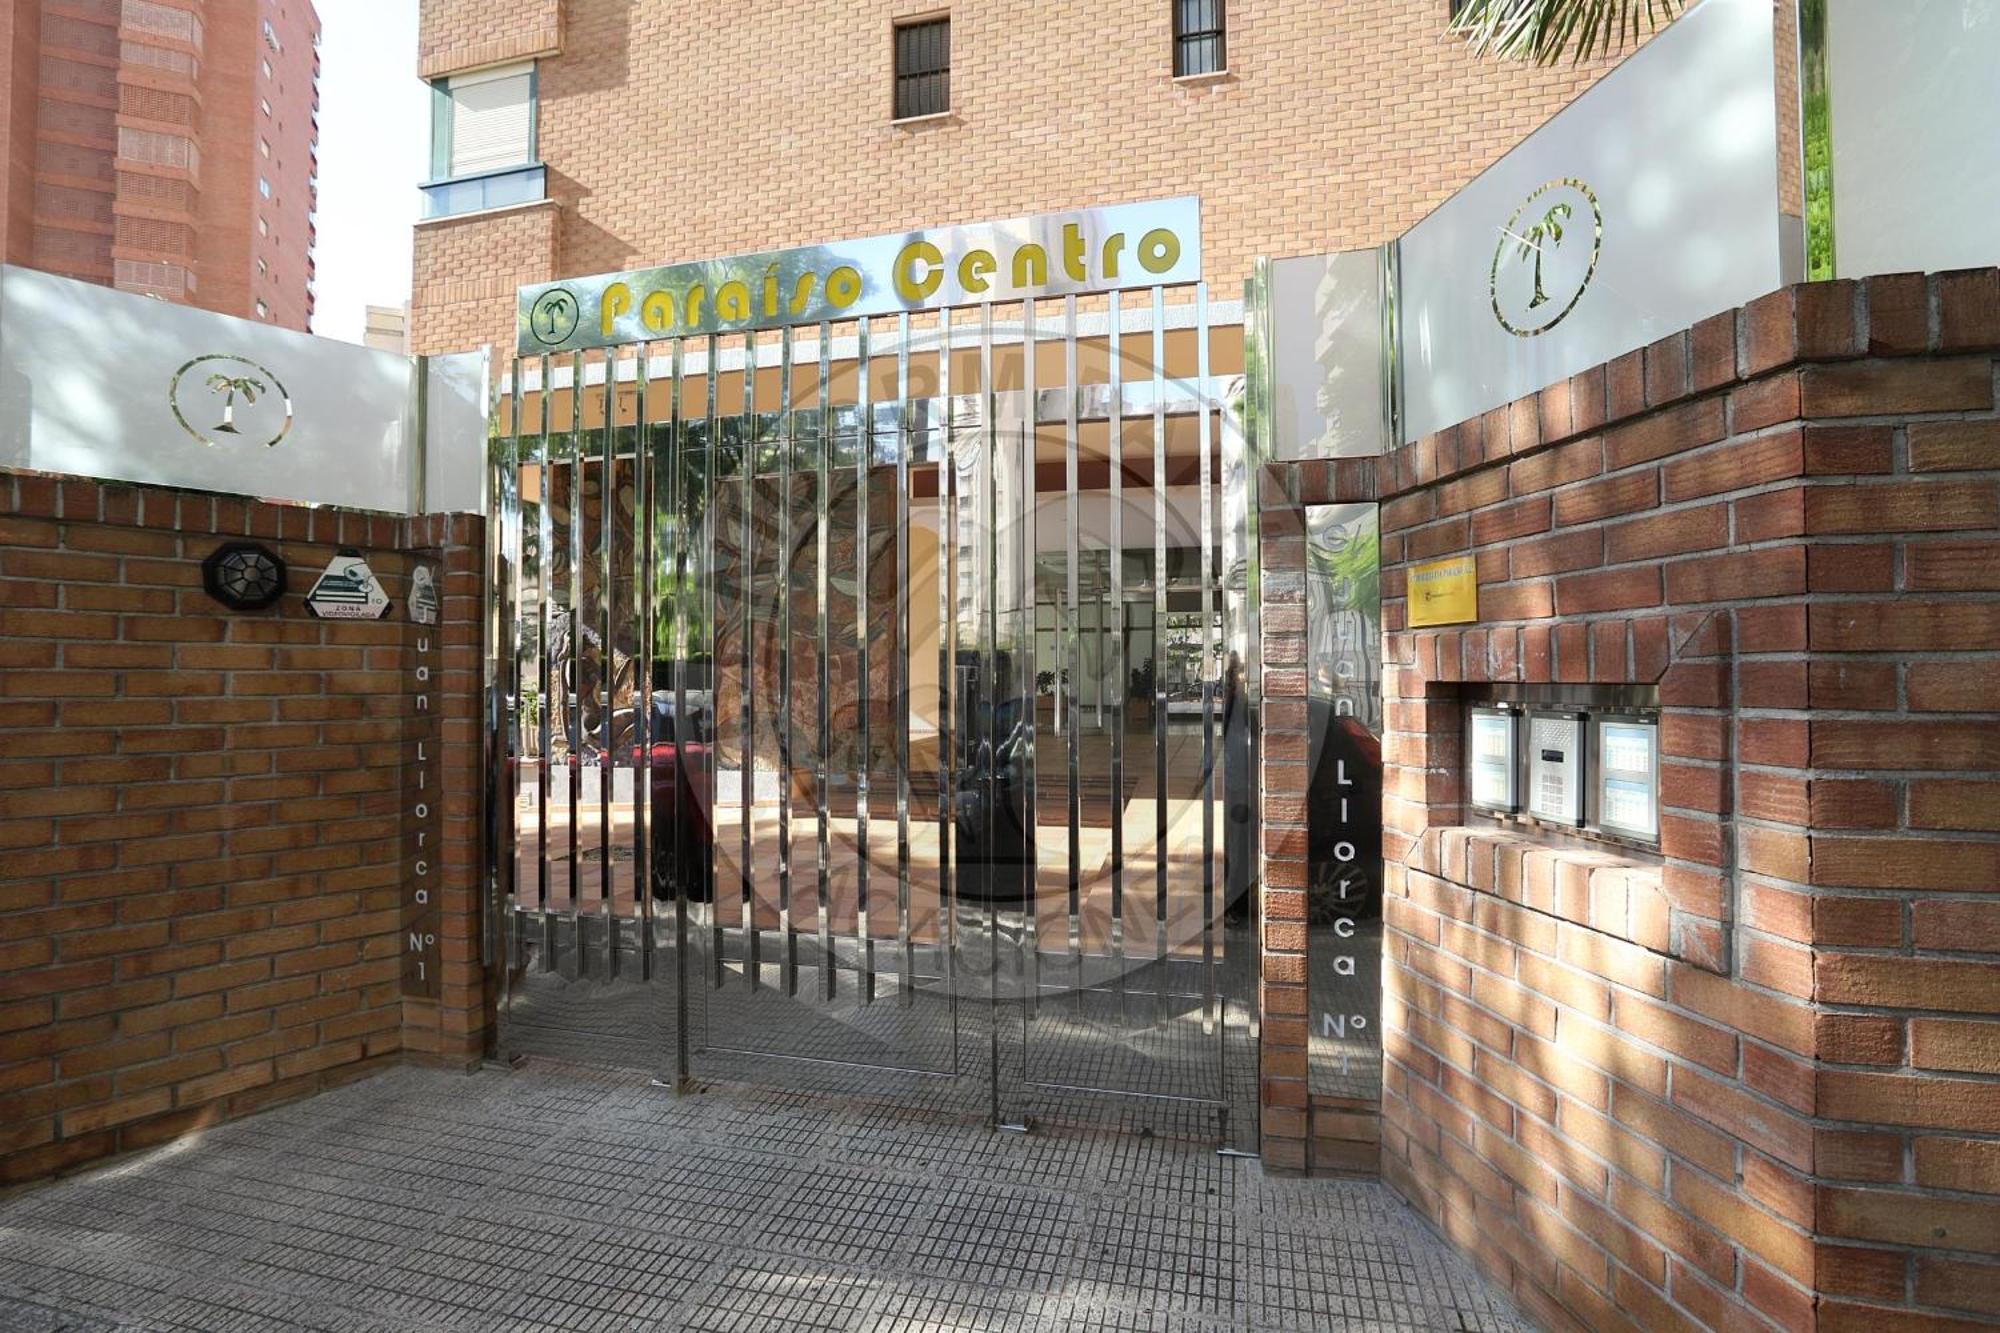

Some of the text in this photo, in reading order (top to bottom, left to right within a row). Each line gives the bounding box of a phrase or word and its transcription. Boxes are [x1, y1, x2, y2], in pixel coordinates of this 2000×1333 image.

[599, 223, 1182, 337] Paraíso Centro
[416, 605, 428, 711] Juan
[415, 741, 428, 905] Llorca
[1333, 758, 1356, 976] Llorca
[418, 962, 425, 981] 1
